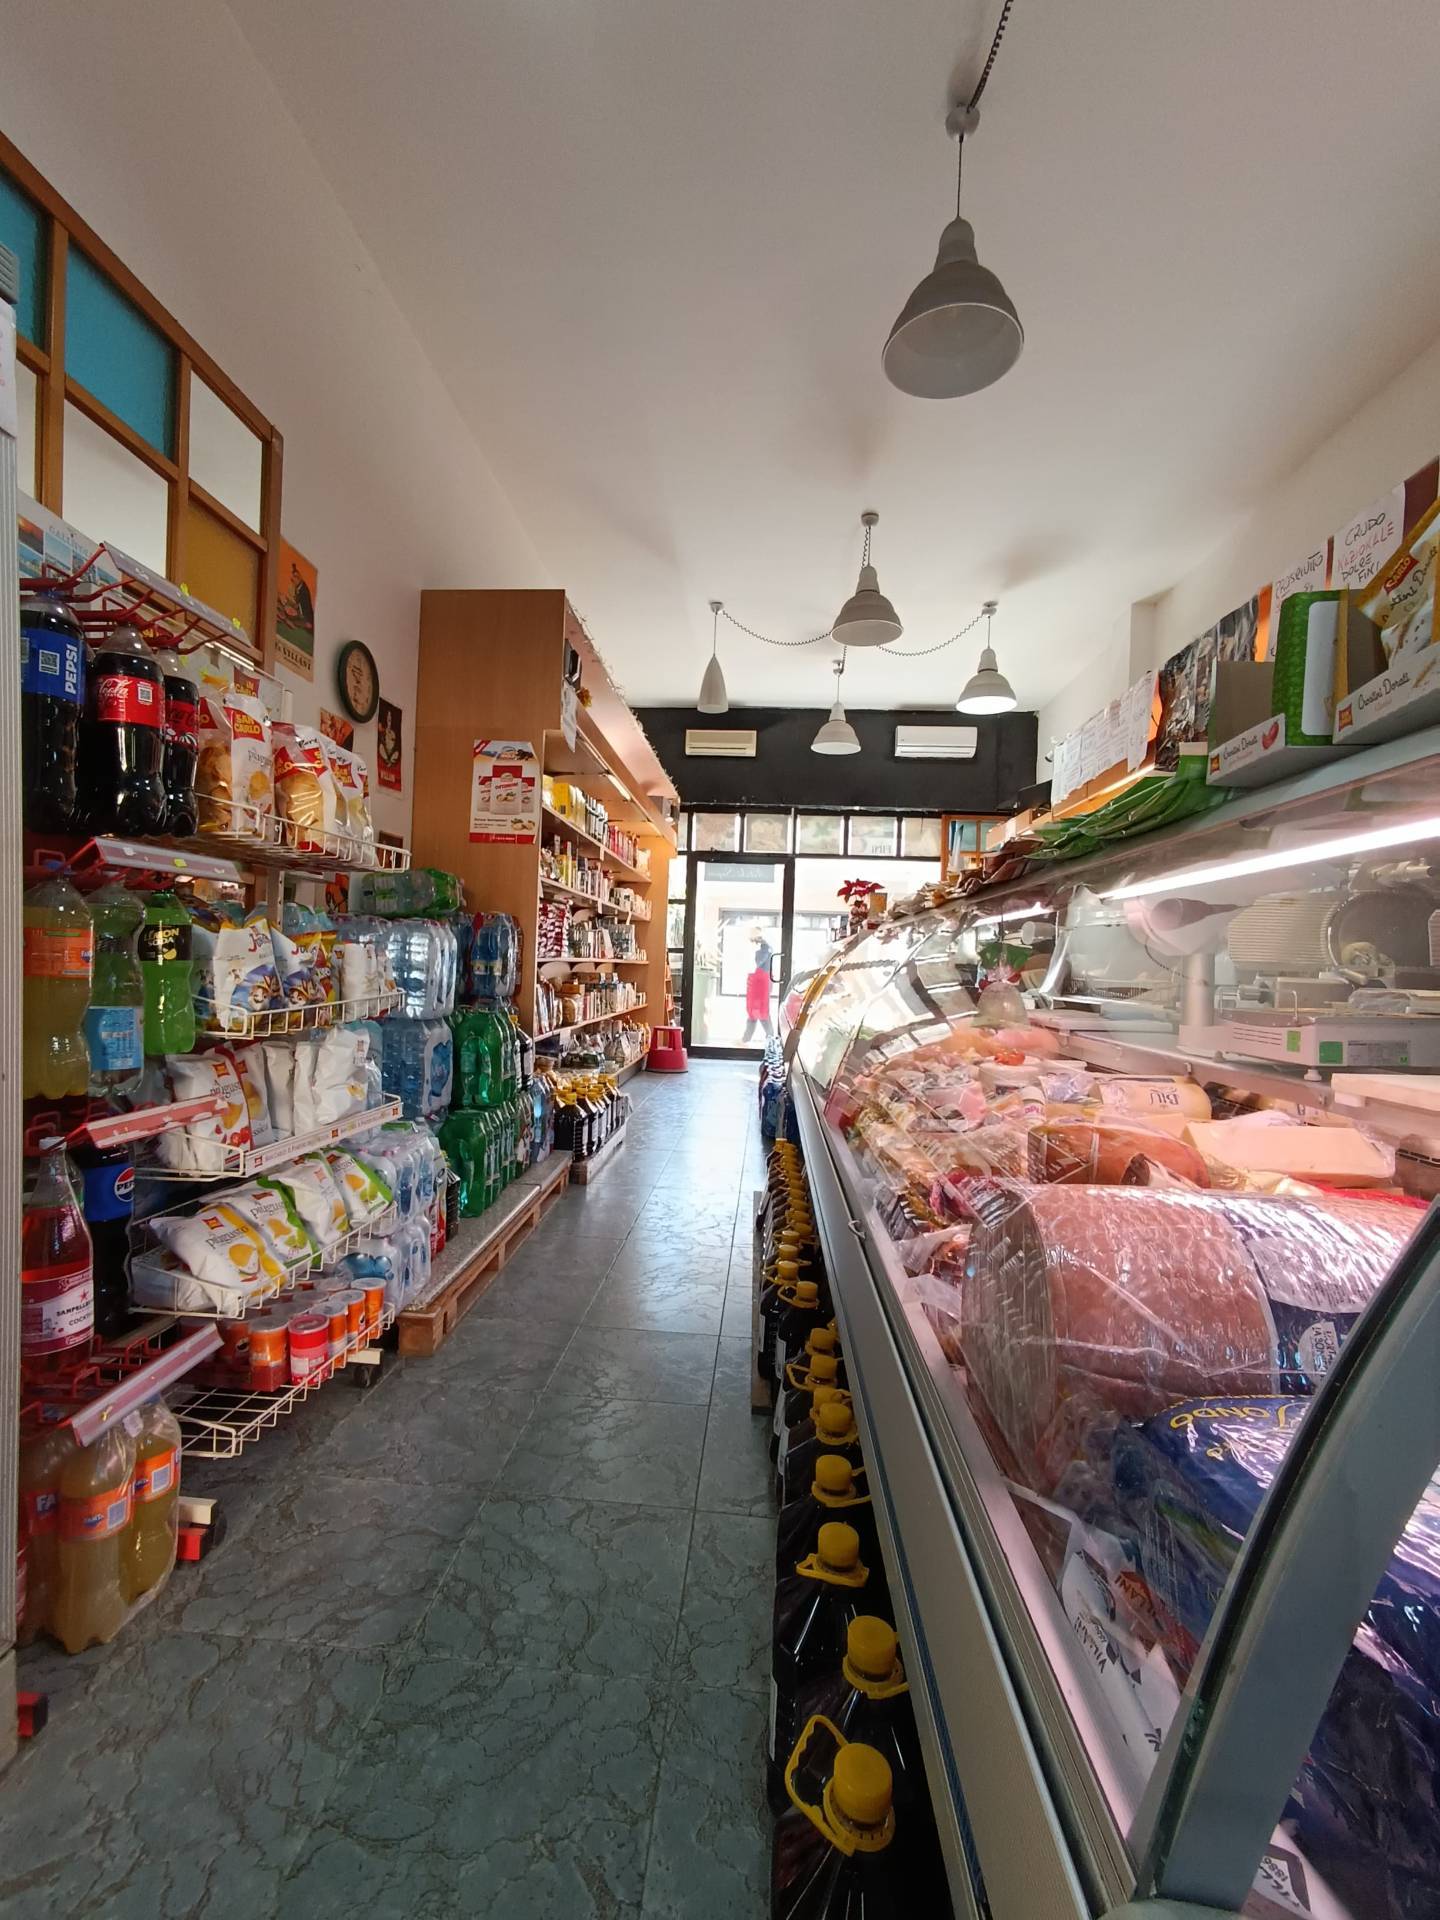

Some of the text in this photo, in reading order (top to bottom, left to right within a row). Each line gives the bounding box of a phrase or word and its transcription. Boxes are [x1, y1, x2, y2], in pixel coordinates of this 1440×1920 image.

[1344, 513, 1386, 546] CRUDO
[64, 643, 78, 695] PEPSI
[233, 722, 261, 736] CARLO
[143, 927, 180, 942] LEMON
[149, 937, 174, 947] SODA
[116, 1181, 134, 1193] PEP
[68, 1313, 91, 1327] COCKT
